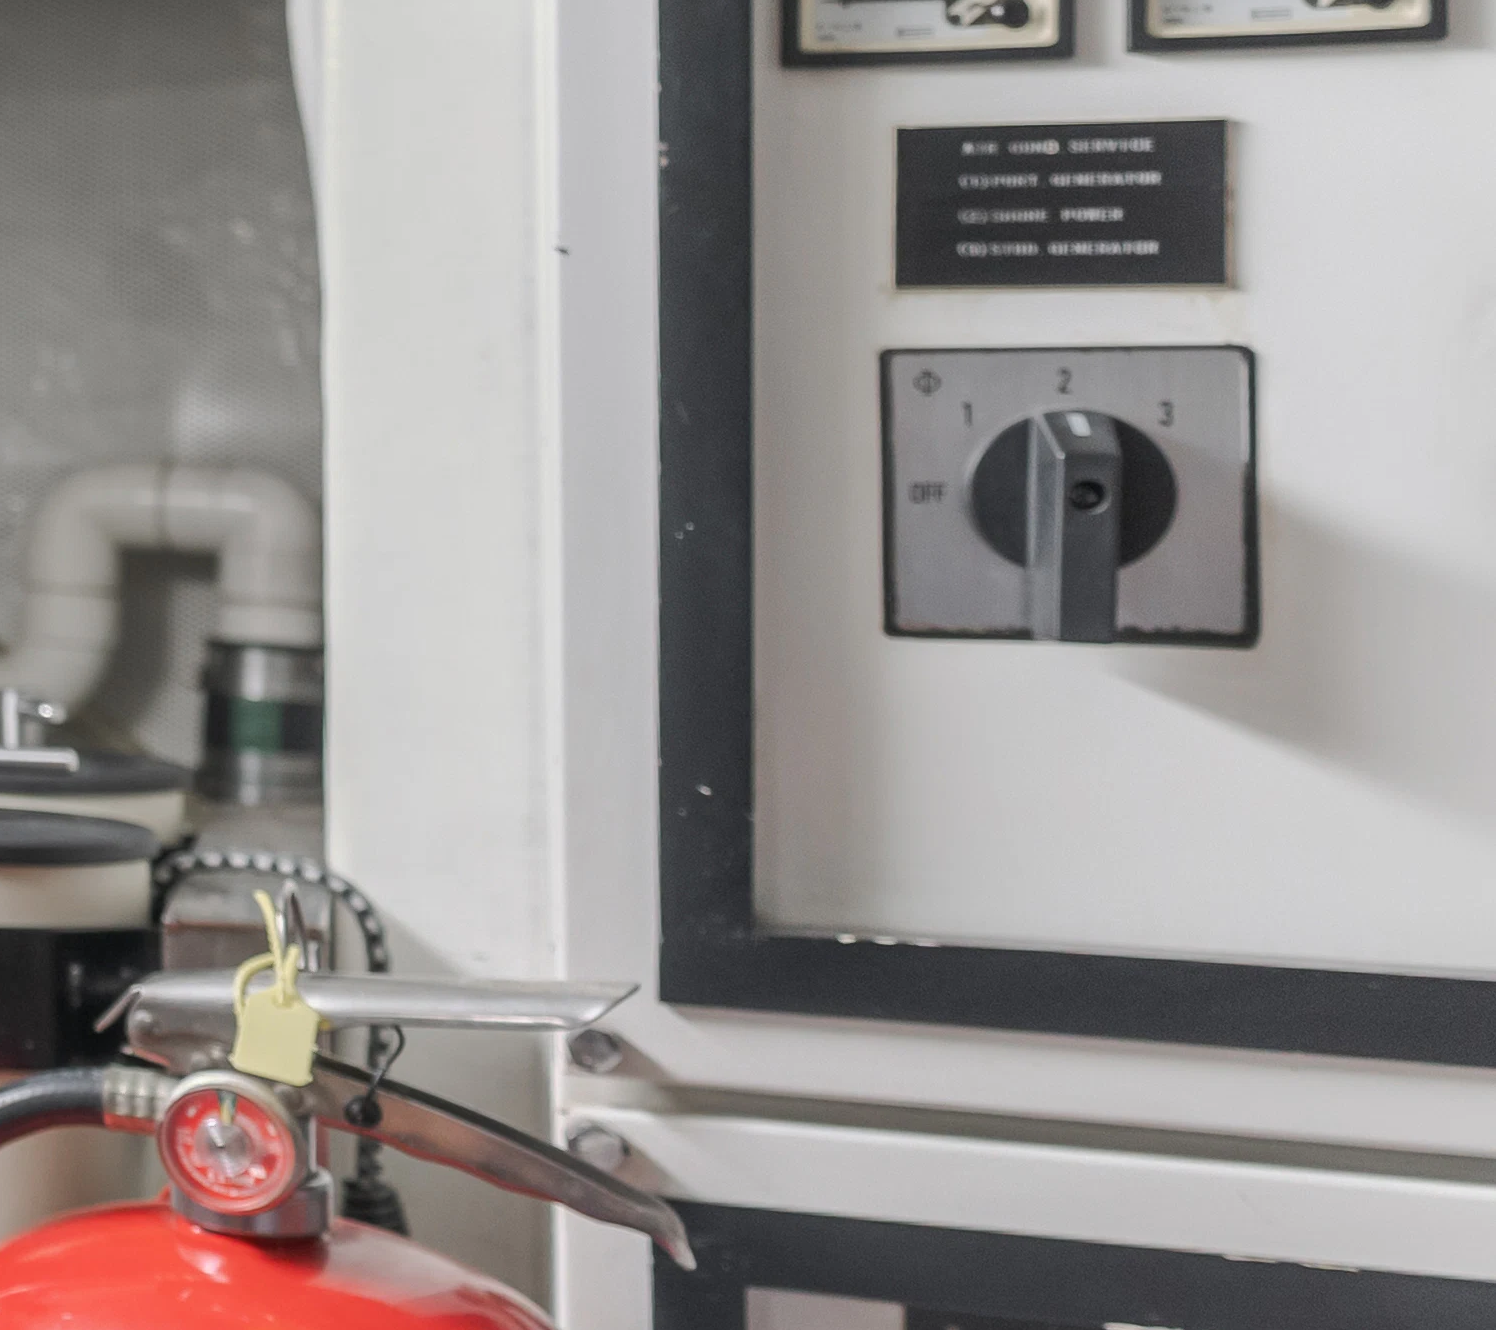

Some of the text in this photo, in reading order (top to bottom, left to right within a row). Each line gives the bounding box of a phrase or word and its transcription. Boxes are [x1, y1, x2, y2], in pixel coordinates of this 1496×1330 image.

[1058, 370, 1073, 394] 2
[962, 402, 974, 426] 1
[1158, 400, 1174, 427] 3
[909, 482, 946, 504] OFF
